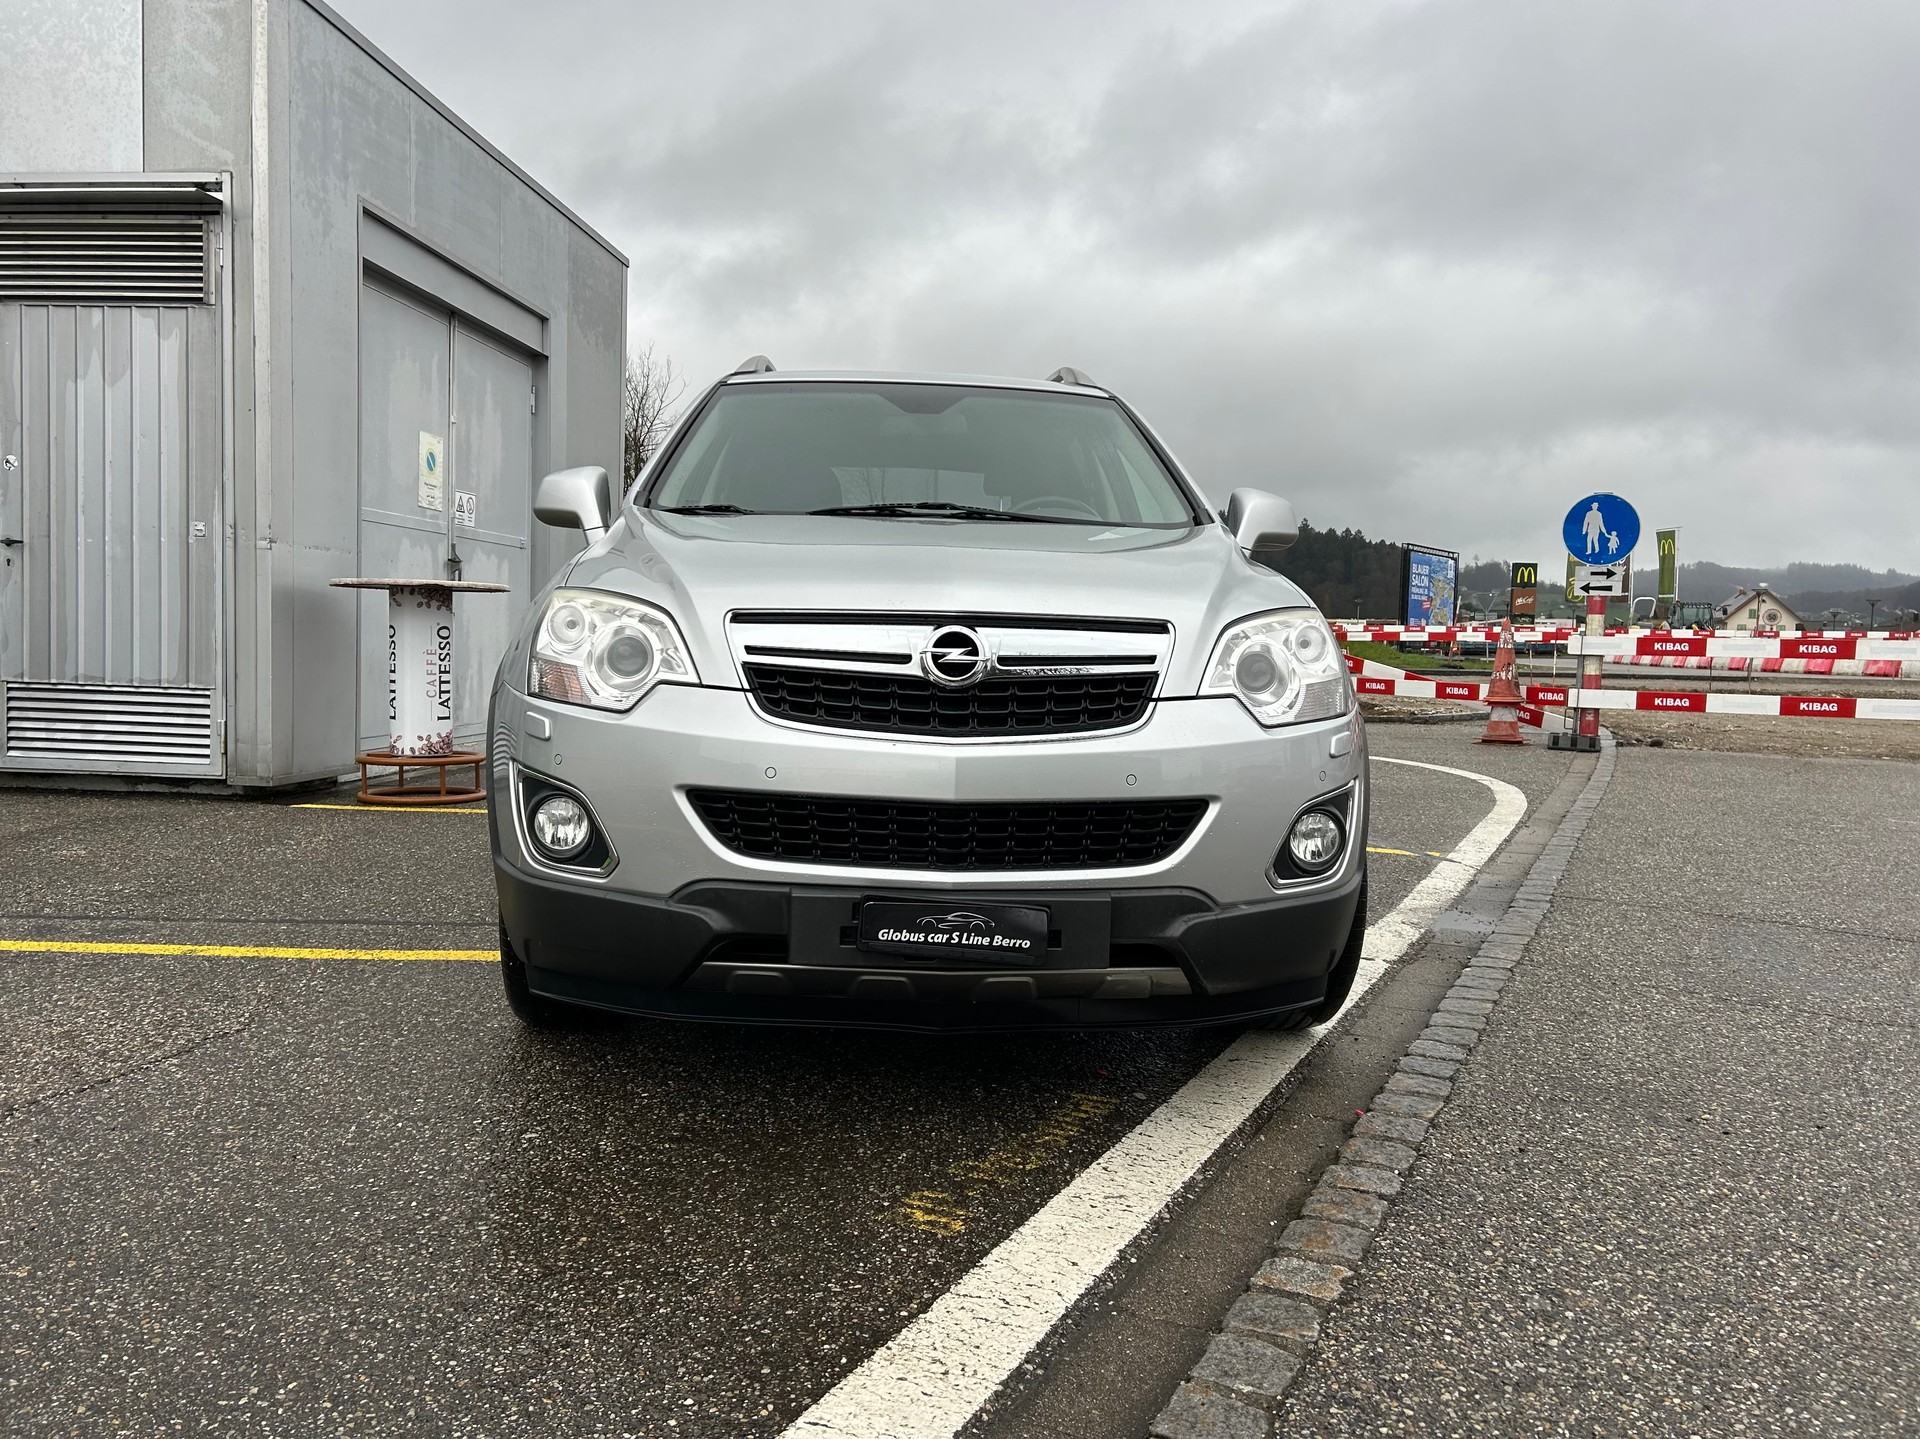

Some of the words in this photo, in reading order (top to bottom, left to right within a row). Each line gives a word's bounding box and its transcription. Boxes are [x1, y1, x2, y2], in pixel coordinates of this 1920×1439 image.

[1412, 564, 1429, 575] BLAUER
[1411, 574, 1429, 587] SALON
[1654, 642, 1690, 651] KIBAG
[1799, 645, 1838, 654] KIBAG
[423, 648, 437, 698] CAFFÈ
[436, 625, 451, 721] LATTESSO
[1365, 682, 1386, 690] KIBAG
[1446, 687, 1469, 695] KIBAG
[1538, 692, 1564, 701] KIBAG
[1654, 697, 1690, 707] KIBAG
[1799, 702, 1838, 712] KIBAG
[878, 929, 925, 943] Globus
[927, 932, 949, 944] car
[950, 932, 960, 944] S
[961, 932, 990, 946] Line
[992, 934, 1031, 949] Berro
